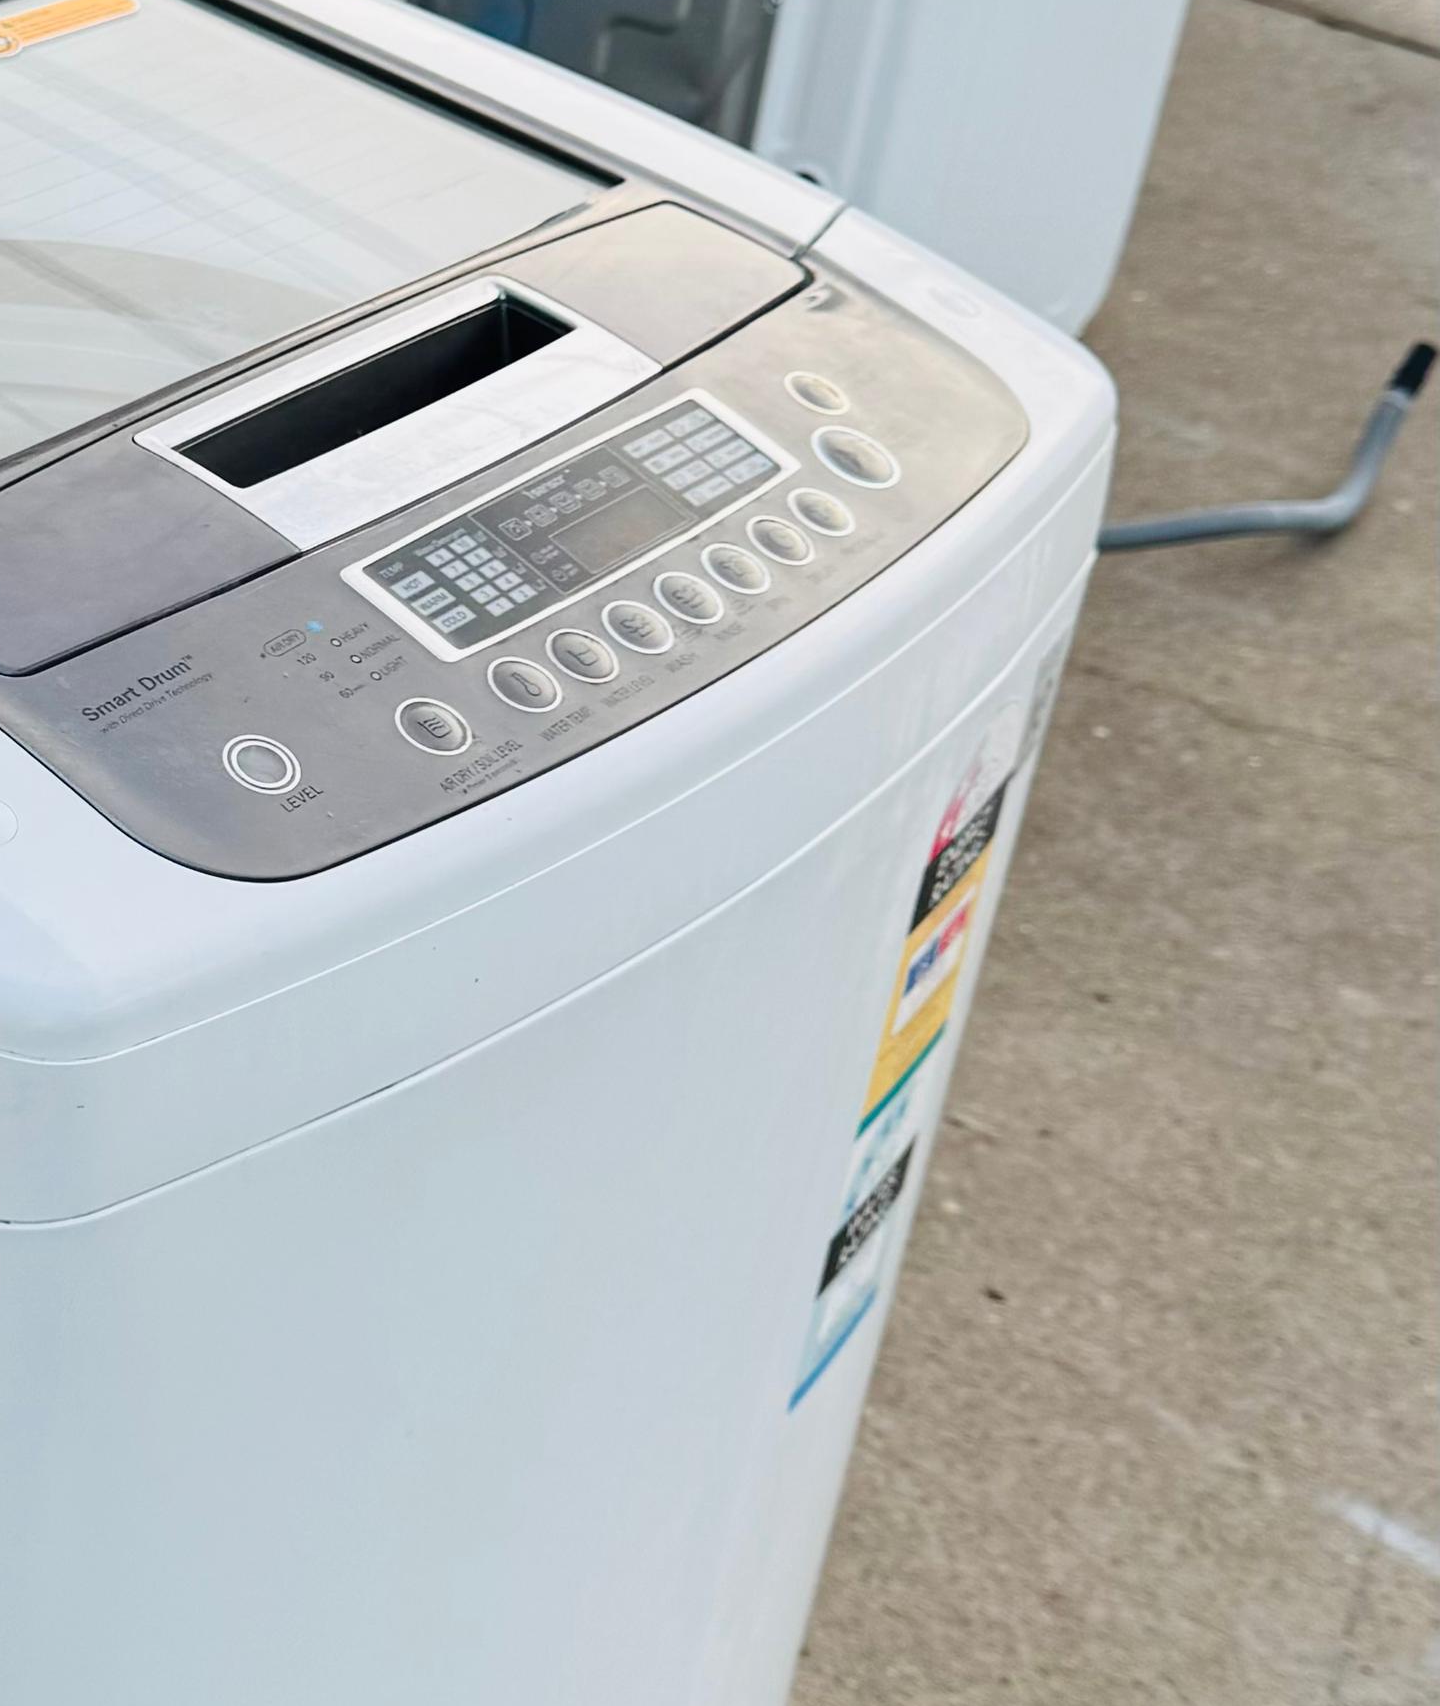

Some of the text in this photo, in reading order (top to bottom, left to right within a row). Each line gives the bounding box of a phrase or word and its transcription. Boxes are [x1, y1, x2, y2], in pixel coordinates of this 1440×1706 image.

[441, 611, 467, 628] COLD
[339, 622, 369, 643] HEAVY
[360, 634, 401, 659] NORMAL
[297, 653, 317, 666] 120
[380, 655, 408, 676] LIGHT
[142, 695, 167, 711] Drive
[165, 673, 213, 699] Technology
[81, 687, 142, 722] Smart
[280, 785, 324, 812] LEVEL
